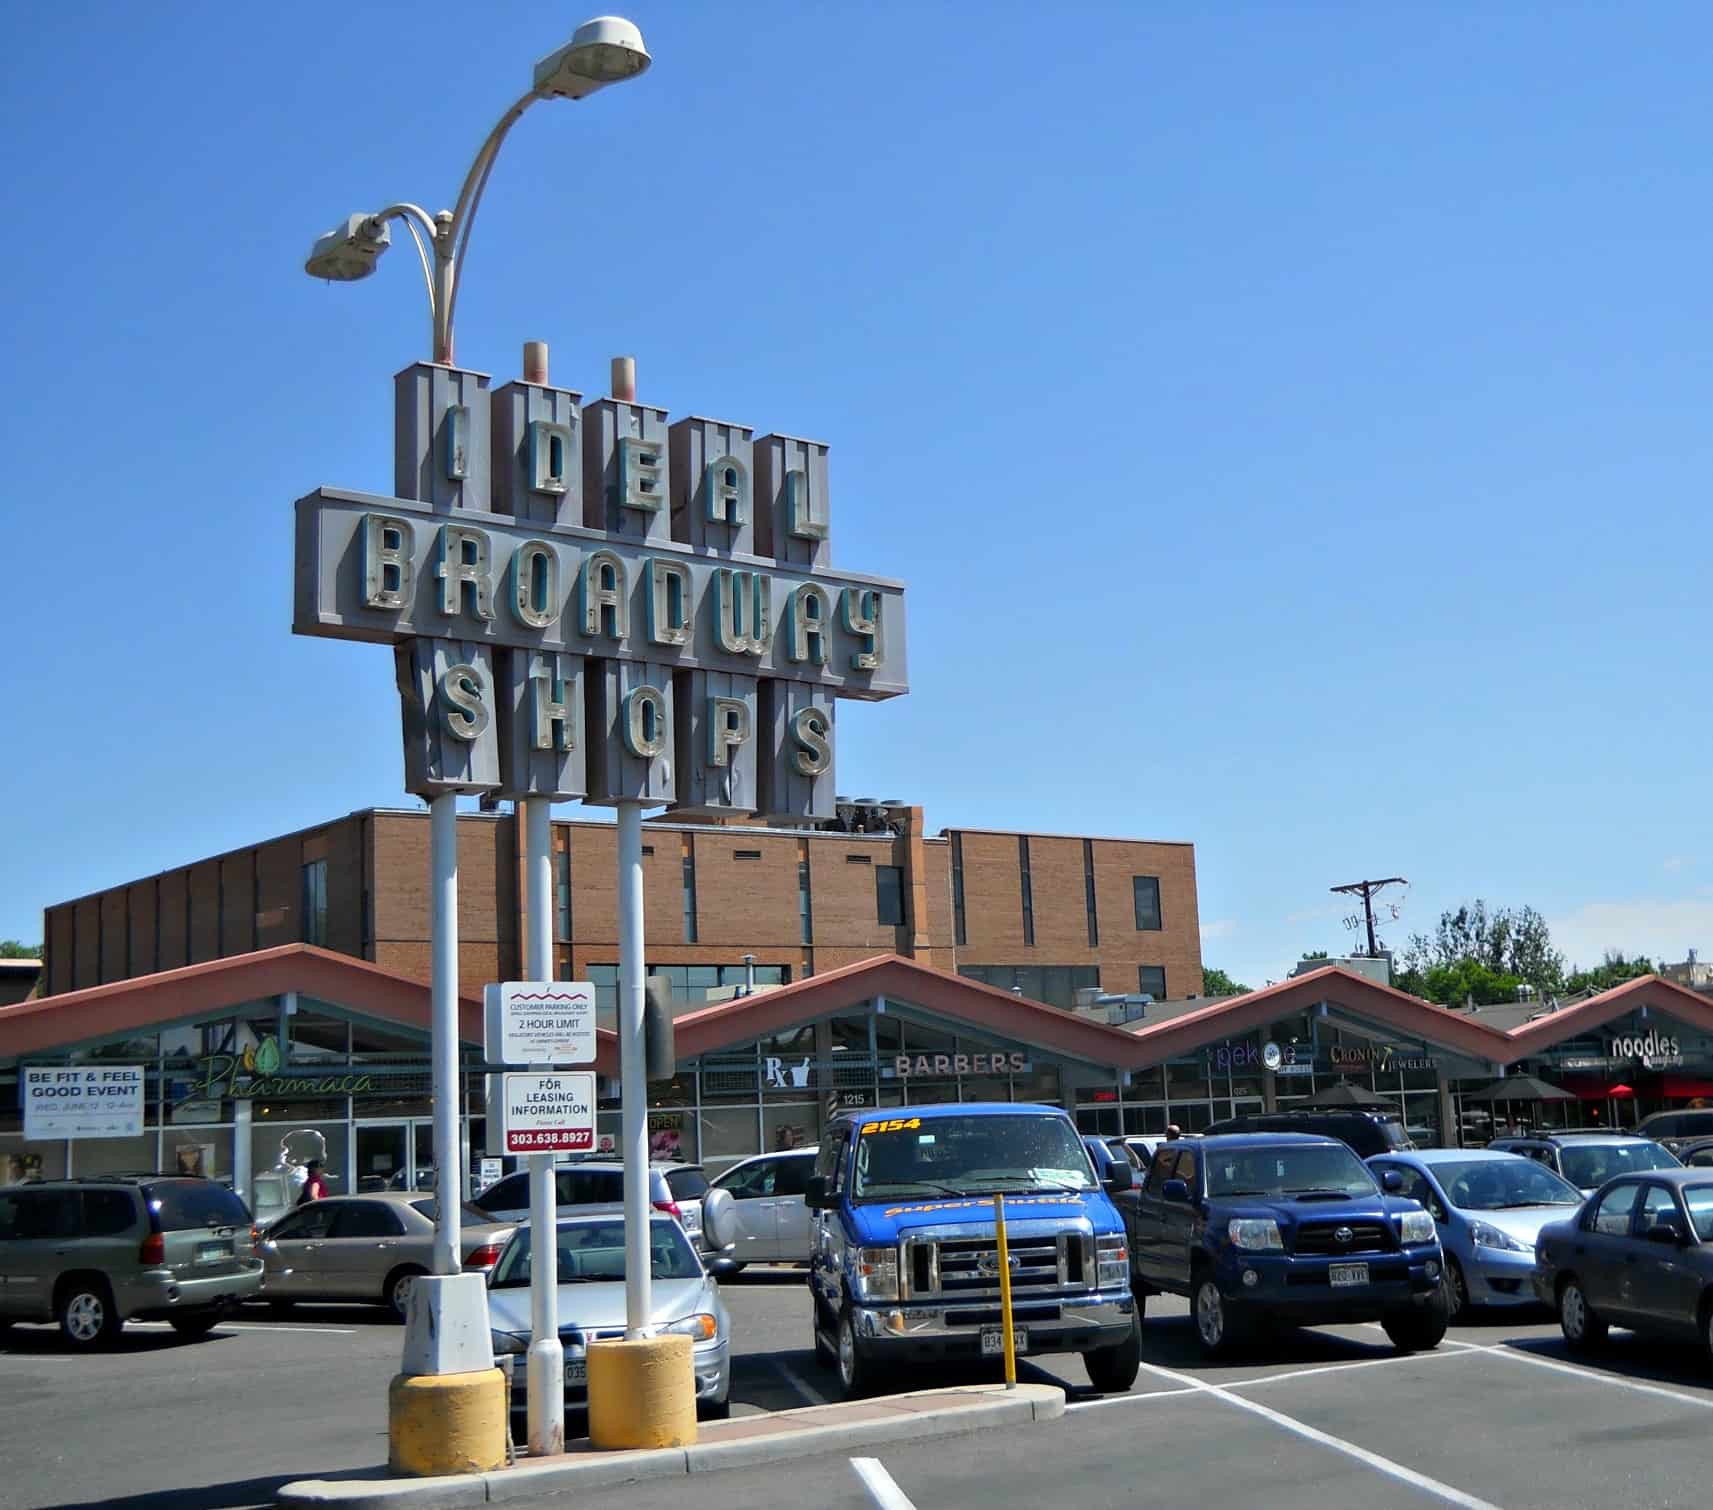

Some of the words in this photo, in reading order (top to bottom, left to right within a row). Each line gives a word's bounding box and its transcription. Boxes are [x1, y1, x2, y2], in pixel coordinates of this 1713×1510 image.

[446, 404, 828, 541] IDEAL
[360, 512, 883, 671] BROADWAY
[438, 663, 833, 778] SHOPS
[519, 1019, 526, 1029] 2
[527, 1019, 554, 1029] HOUR
[556, 1019, 580, 1029] LIMIT
[1612, 1027, 1680, 1057] noodles
[896, 1053, 1025, 1077] BARBERS
[29, 1072, 52, 1083] BE
[57, 1071, 81, 1082] FIT
[86, 1071, 97, 1081] &
[103, 1071, 141, 1081] FEEL
[191, 1054, 374, 1098] Pharmaca
[32, 1086, 82, 1098] GOOD
[88, 1085, 138, 1096] EVENT
[539, 1080, 561, 1090] FOR
[526, 1092, 574, 1102] LEASING
[844, 1094, 865, 1105] 1215
[511, 1105, 588, 1115] INFORMATION
[860, 1118, 921, 1135] 2154
[511, 1132, 590, 1145] 303.638.8927
